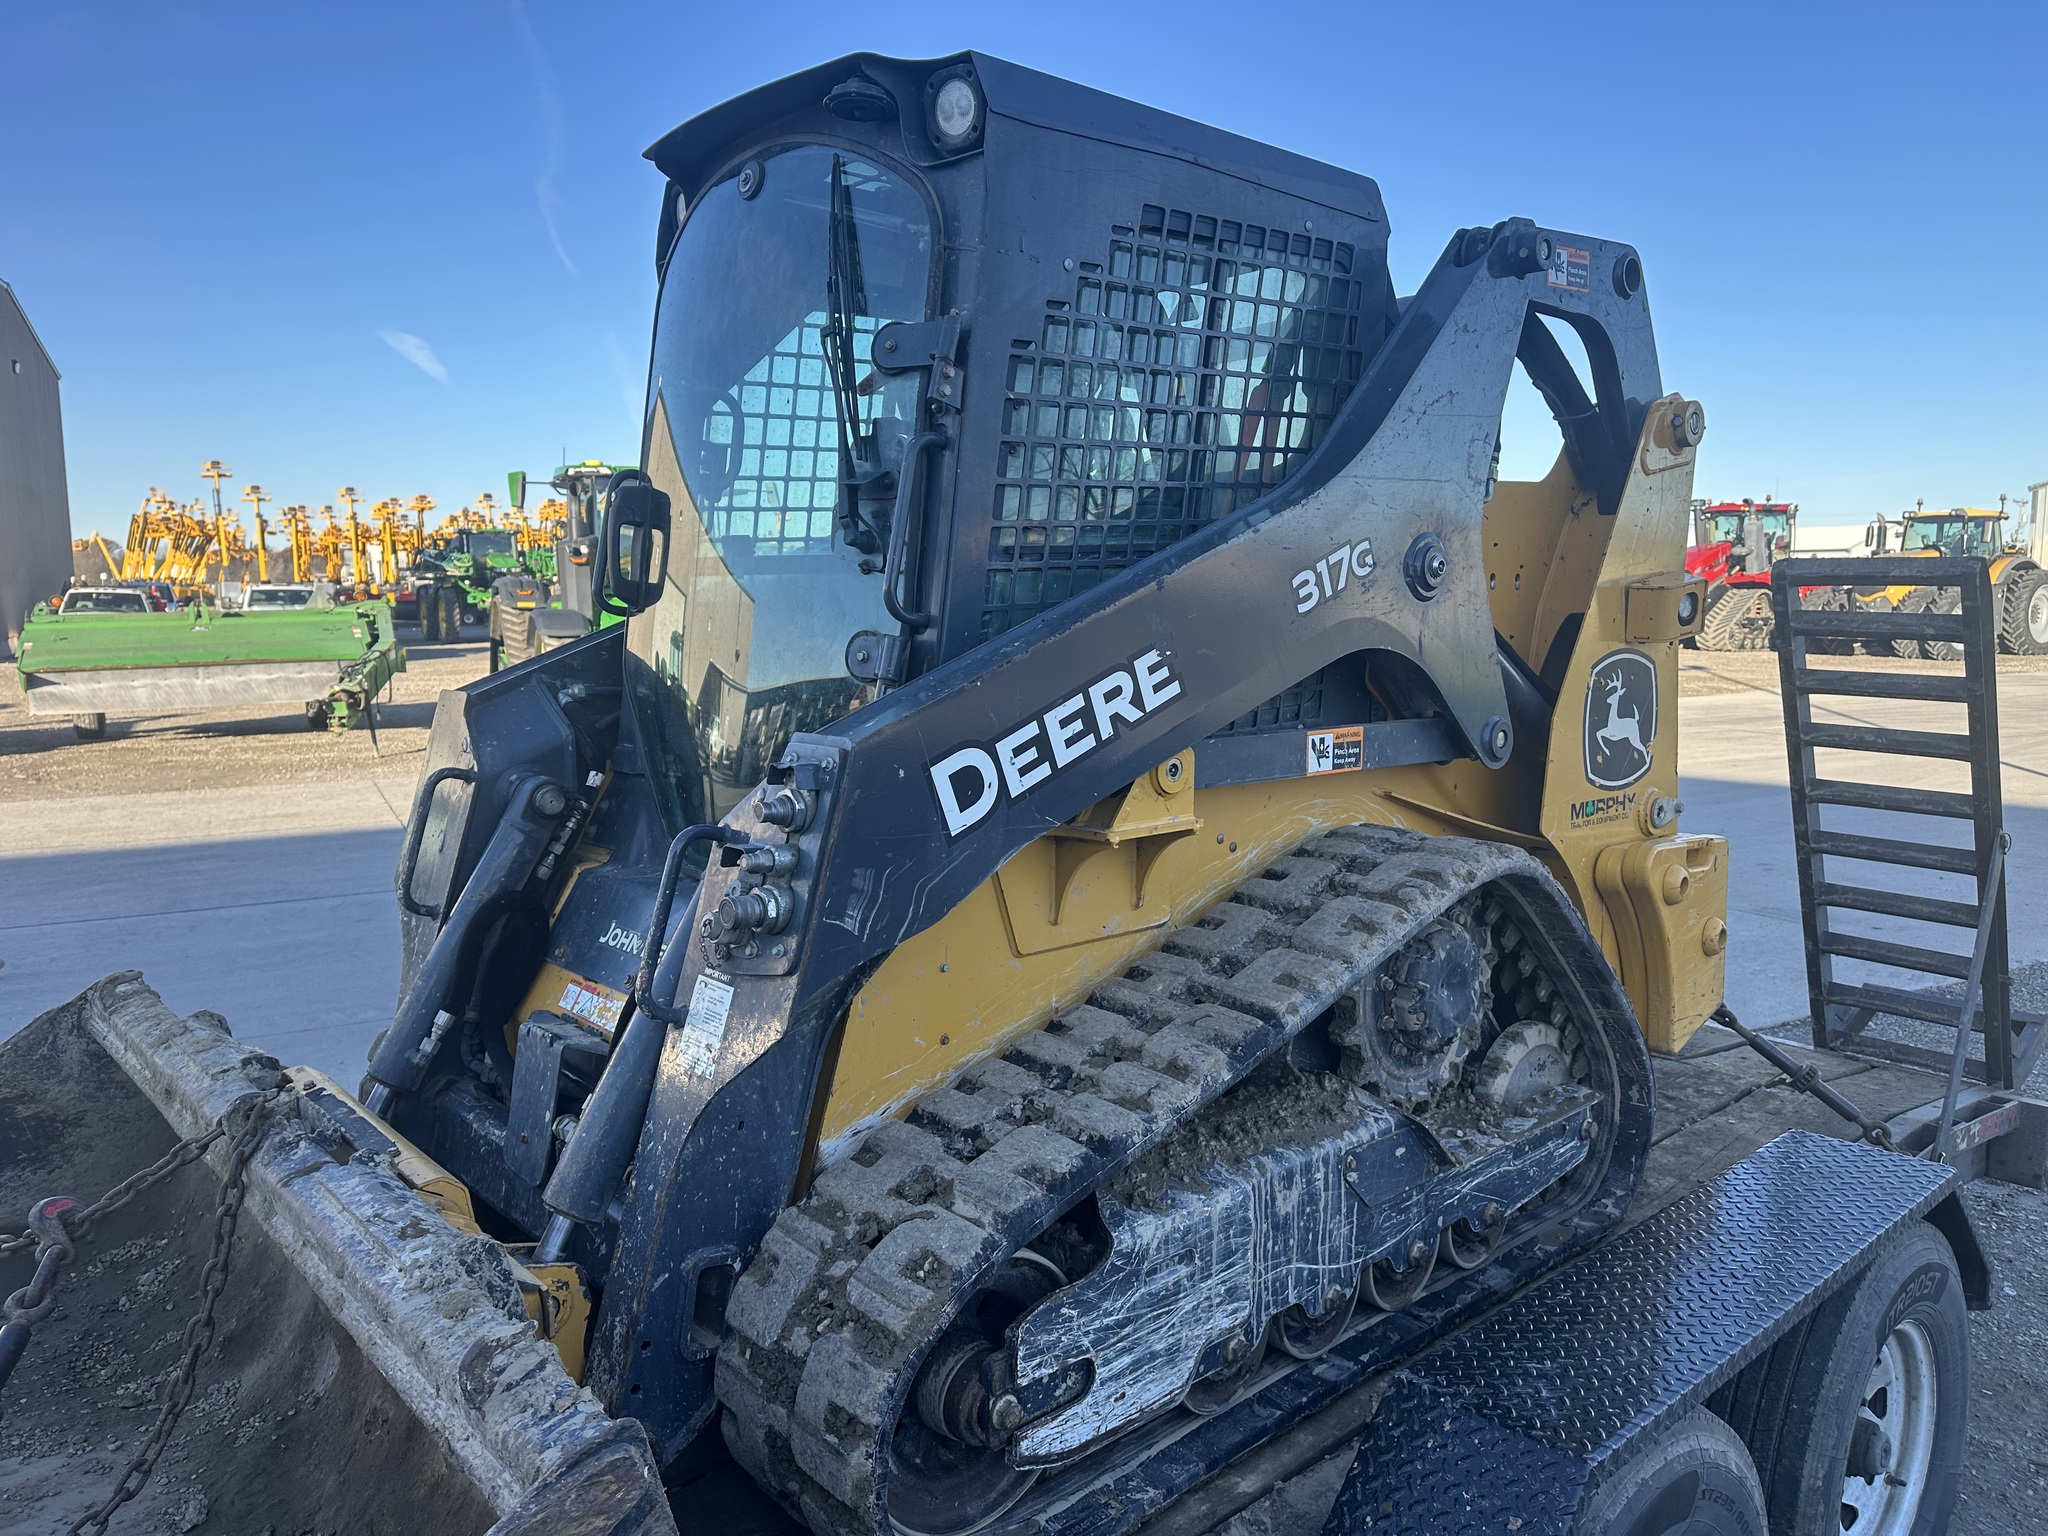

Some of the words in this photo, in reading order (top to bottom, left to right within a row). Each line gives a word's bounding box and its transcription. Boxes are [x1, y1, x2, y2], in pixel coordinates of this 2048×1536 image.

[1292, 540, 1374, 614] 317G
[930, 648, 1181, 837] DEERE
[599, 922, 643, 955] JOHN
[704, 967, 731, 983] IMPORTANT
